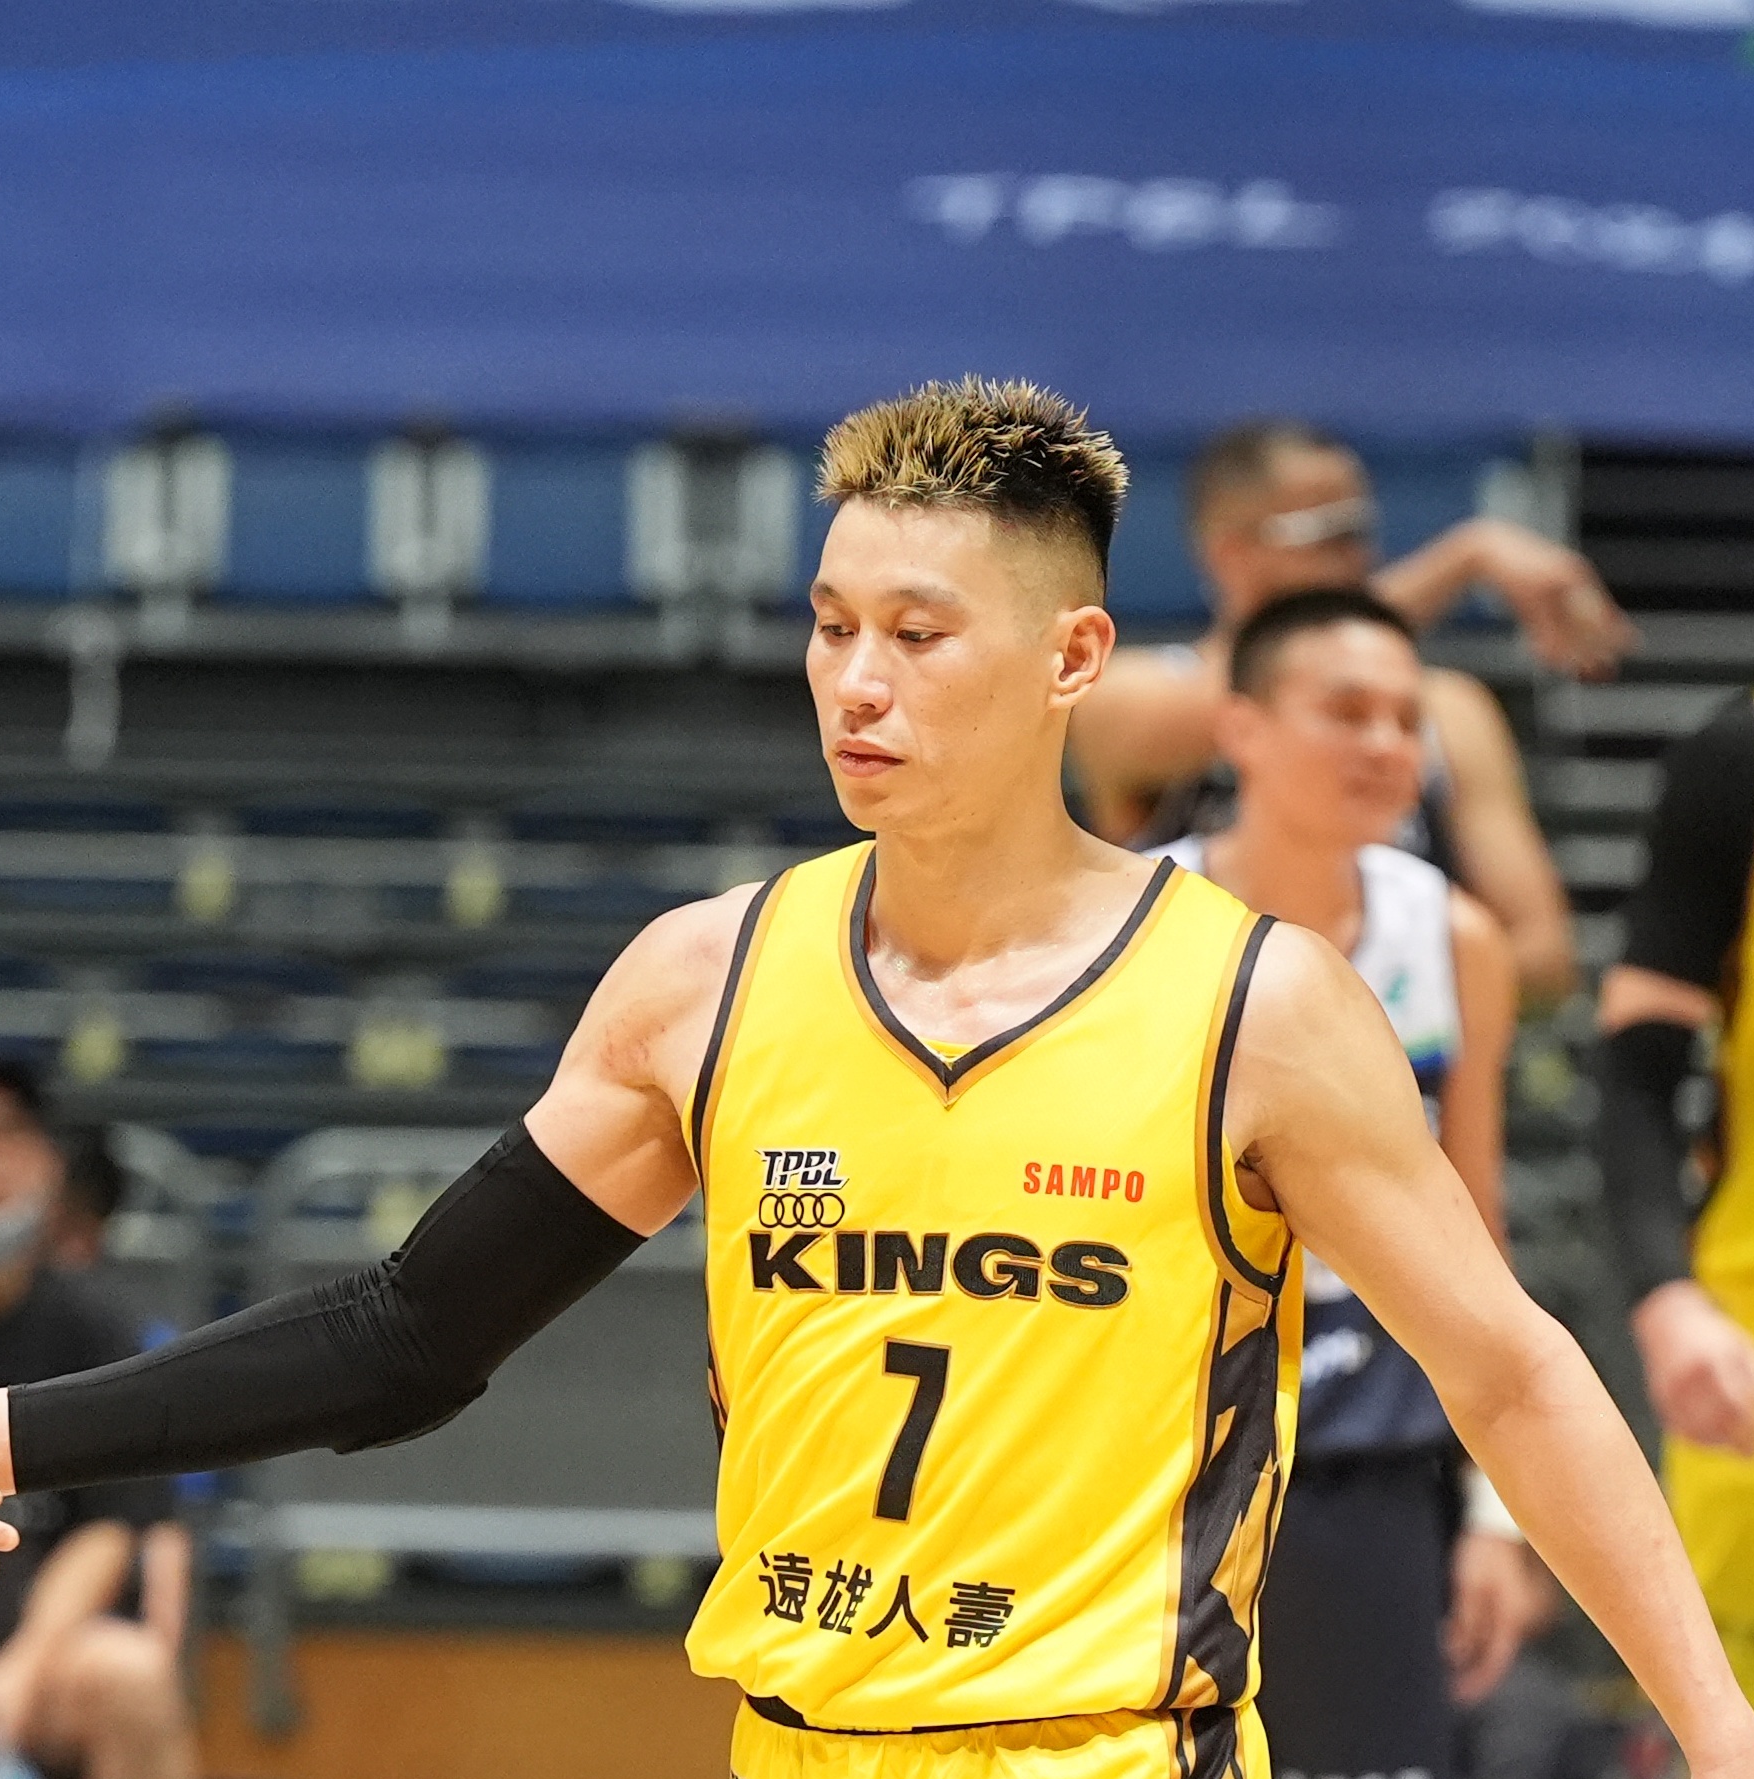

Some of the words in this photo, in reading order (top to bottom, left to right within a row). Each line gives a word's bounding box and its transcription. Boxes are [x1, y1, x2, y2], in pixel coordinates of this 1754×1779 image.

[757, 1149, 849, 1190] TPBL
[1023, 1162, 1145, 1203] SAMPO
[747, 1230, 1132, 1310] KINGS
[872, 1336, 952, 1525] 7
[758, 1550, 1017, 1649] 遠雄人壽
